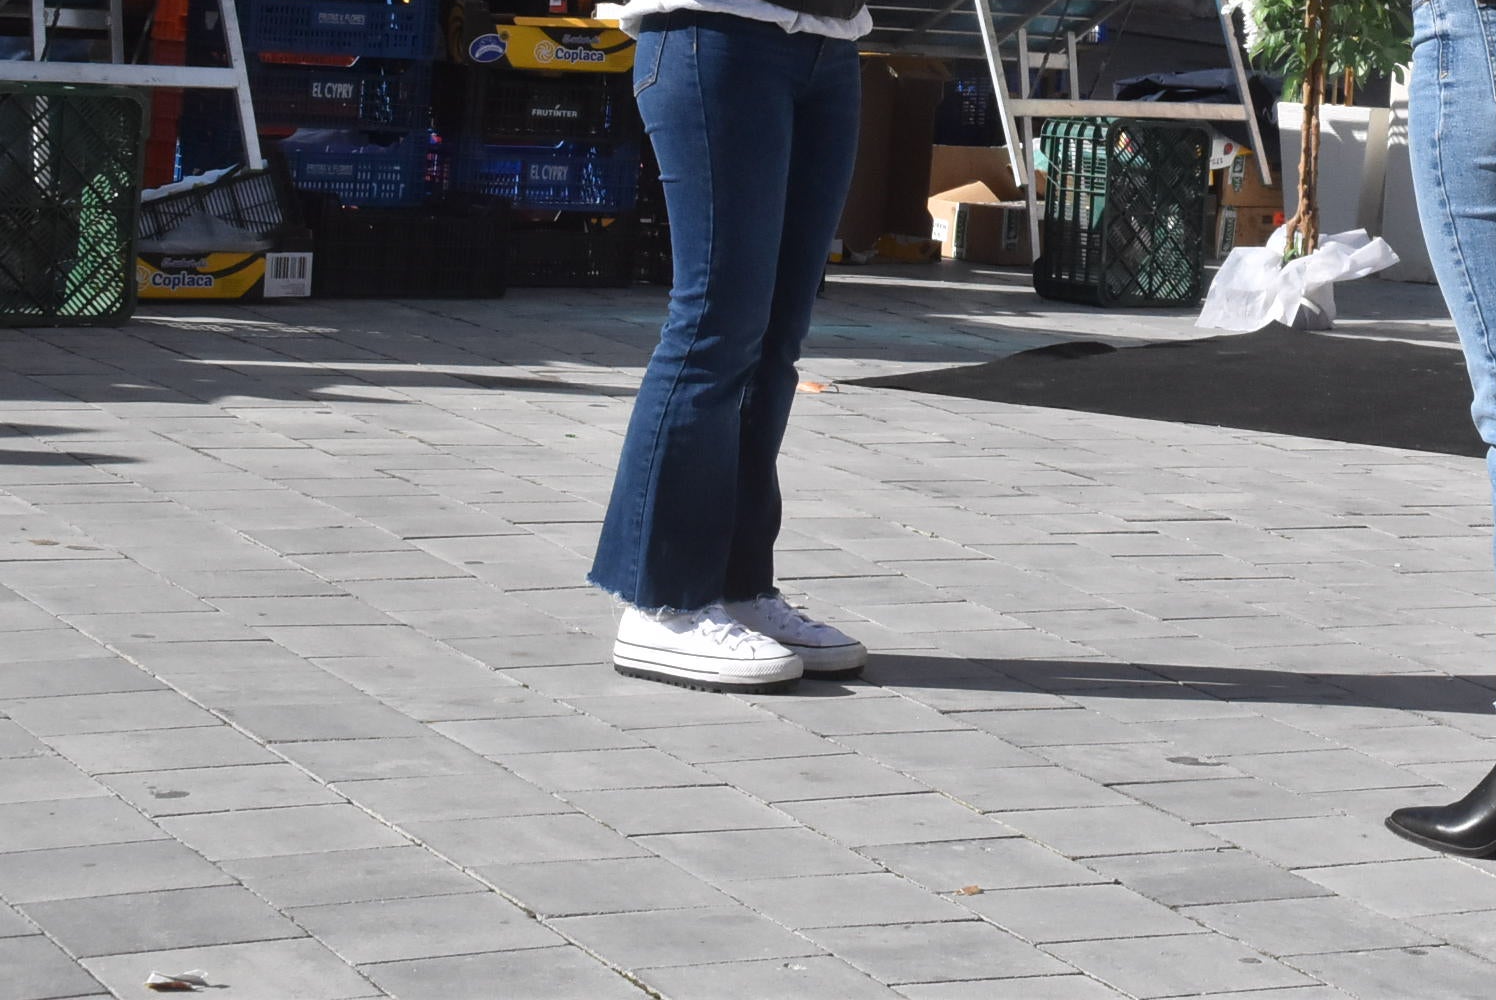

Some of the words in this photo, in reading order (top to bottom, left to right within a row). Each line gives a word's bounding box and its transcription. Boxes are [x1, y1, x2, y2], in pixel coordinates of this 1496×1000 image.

[555, 46, 606, 64] Coplaca
[312, 81, 323, 98] EL
[324, 82, 354, 99] CYPRY
[531, 107, 578, 118] FRUTINTER
[530, 164, 540, 180] EL
[541, 164, 569, 181] CYPRY
[151, 270, 214, 290] Coplaca
